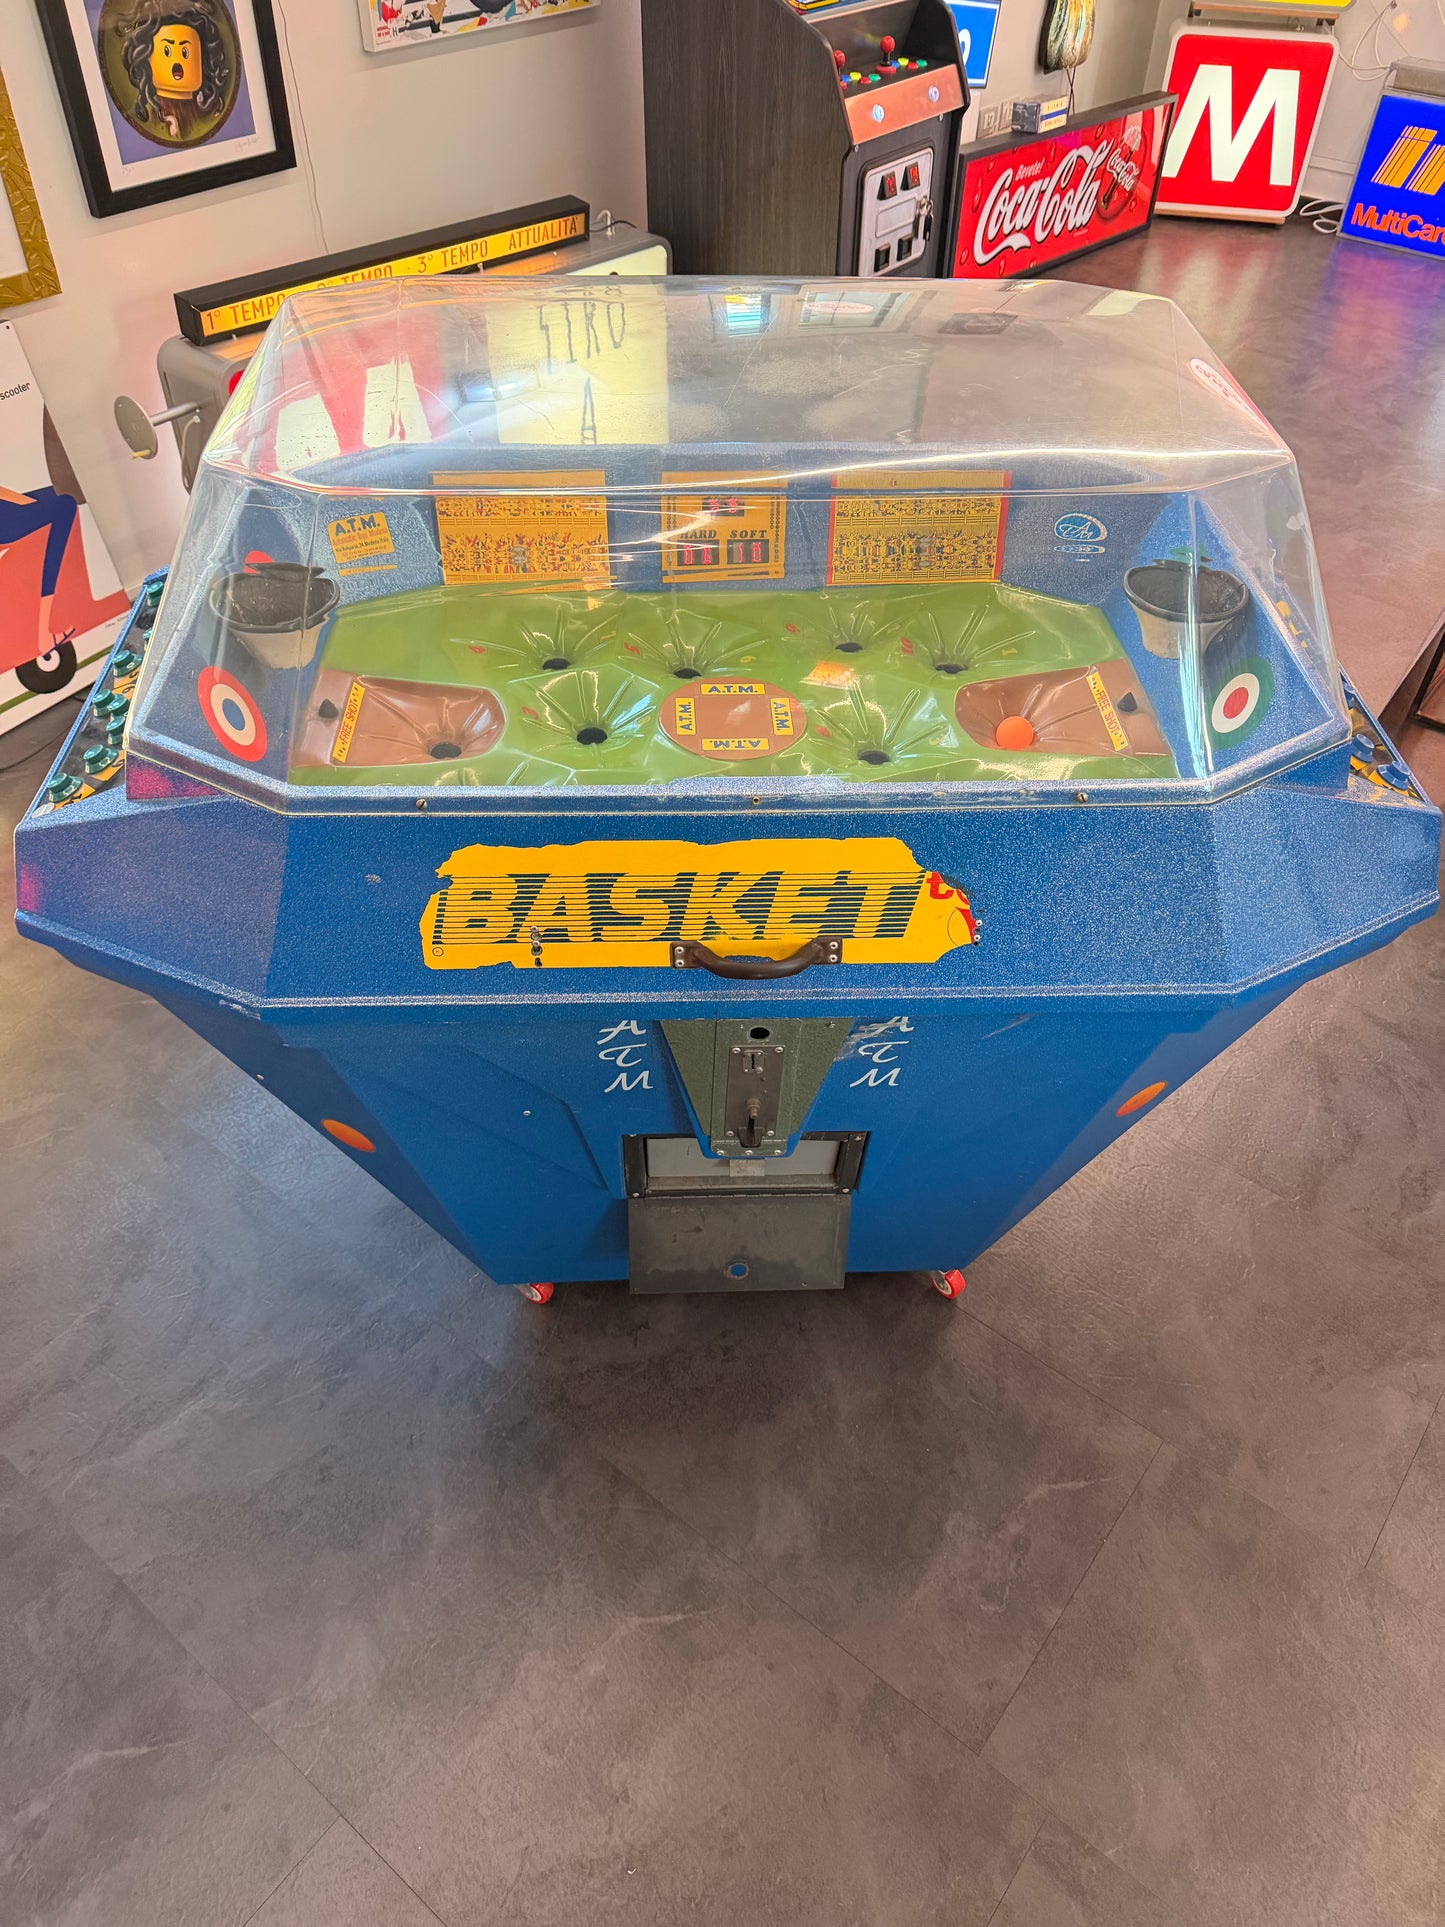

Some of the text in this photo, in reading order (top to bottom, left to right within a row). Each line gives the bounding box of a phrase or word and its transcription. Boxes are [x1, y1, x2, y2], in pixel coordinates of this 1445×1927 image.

[1161, 64, 1300, 186] M
[1014, 157, 1045, 182] Bevete!
[973, 138, 1115, 266] Coca-Cola
[1351, 202, 1445, 245] MultiCar
[417, 253, 433, 274] 3°
[441, 240, 489, 268] TEMPO
[508, 215, 579, 251] ATTUALITÀ
[0, 382, 31, 401] scooter
[335, 514, 381, 537] A.T.M.
[729, 529, 768, 539] SOFT
[707, 685, 758, 694] A.T.M.
[339, 699, 359, 745] FREE SHOT
[678, 701, 693, 731] A.T.M.
[773, 701, 790, 731] A.T.M.
[1096, 690, 1120, 733] FREE SHOT
[708, 739, 761, 749] A.T.M.
[431, 869, 926, 945] BASKET
